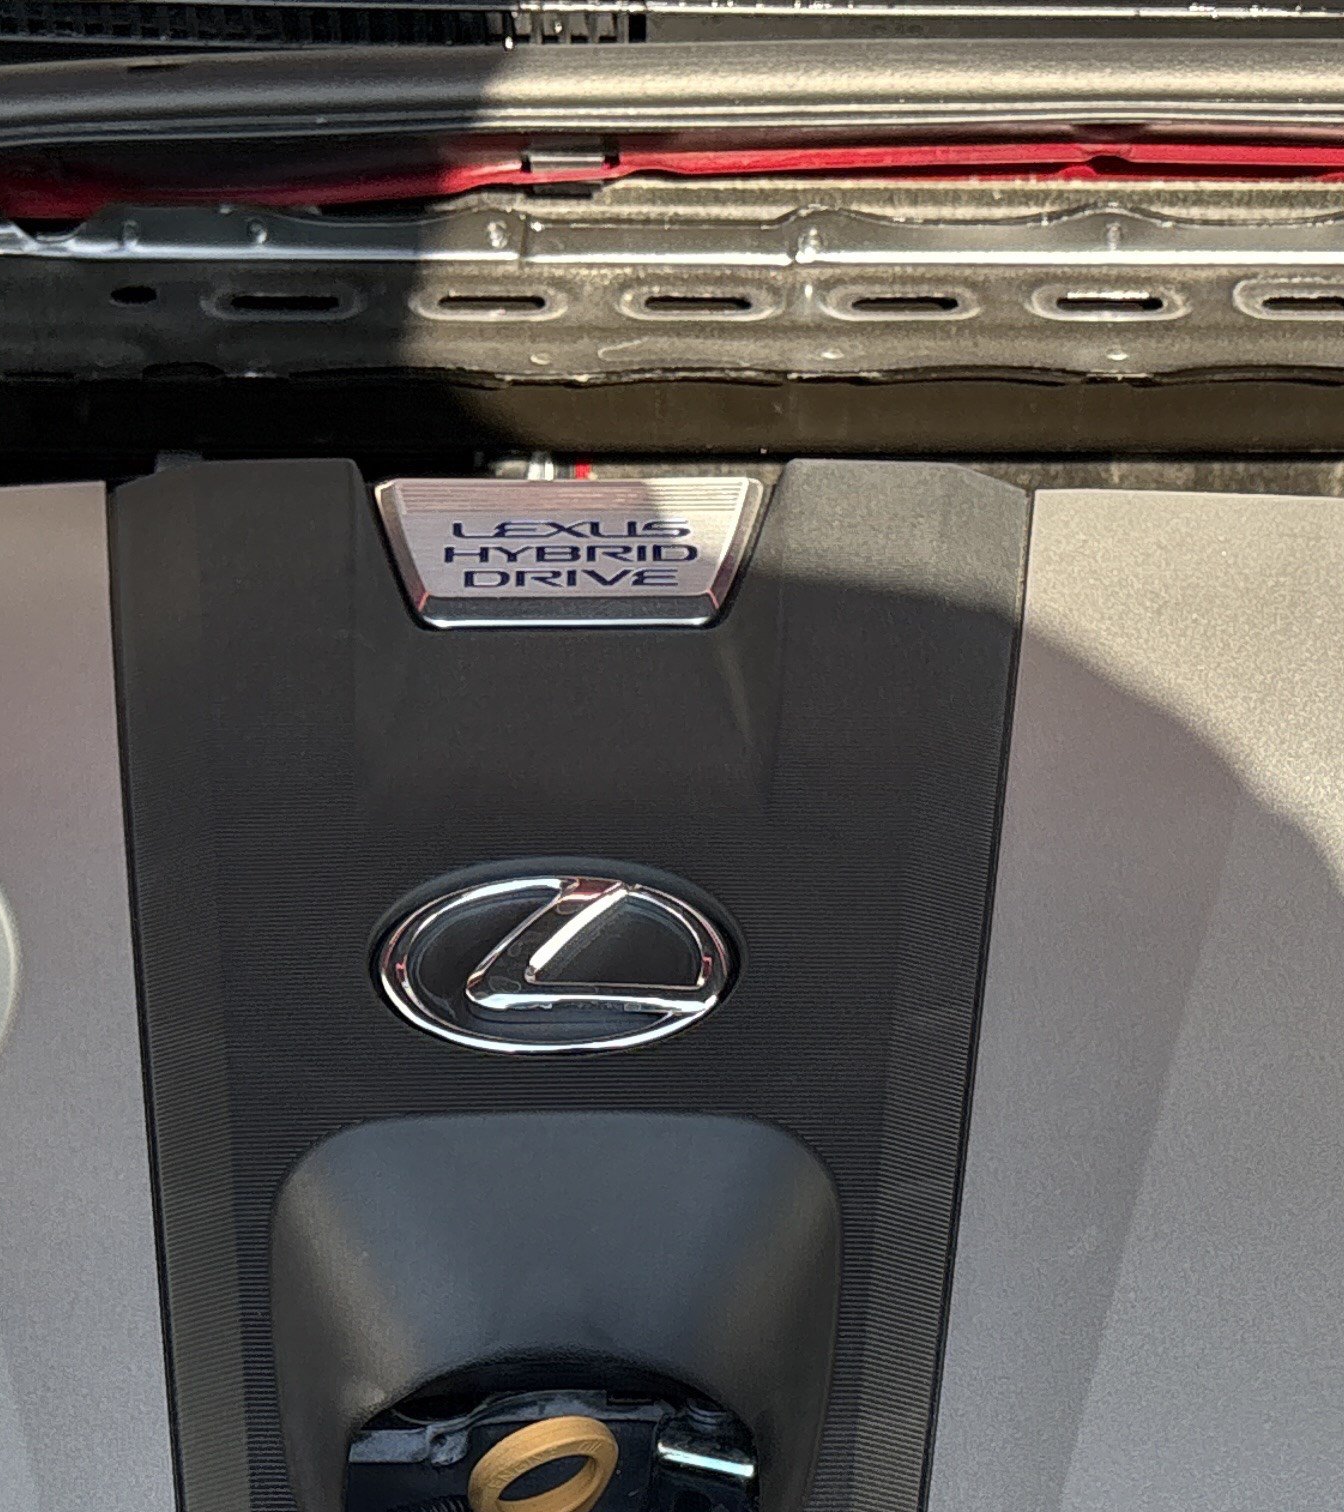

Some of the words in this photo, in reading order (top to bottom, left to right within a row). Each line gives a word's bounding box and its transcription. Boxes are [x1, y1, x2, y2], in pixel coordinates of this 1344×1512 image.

[452, 520, 692, 539] LEXUS
[443, 544, 698, 563] HYBRID
[463, 568, 679, 588] DRIVE
